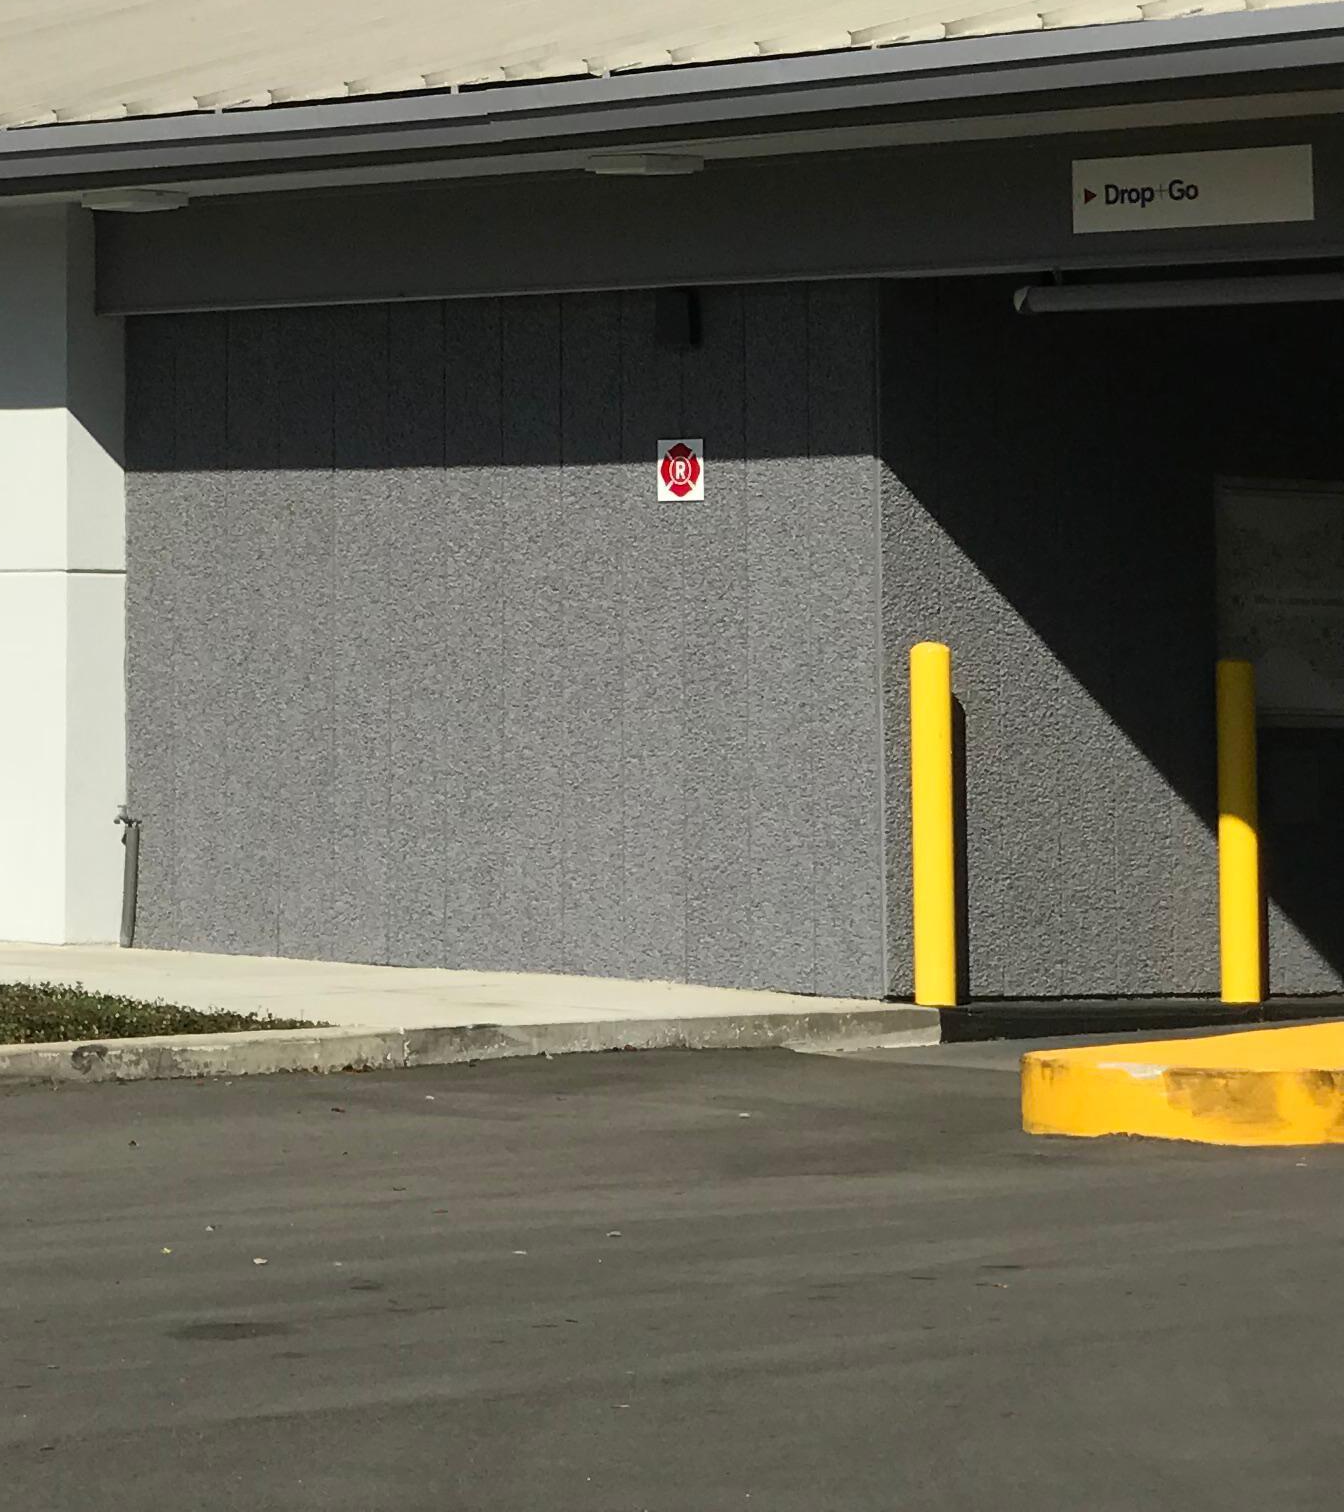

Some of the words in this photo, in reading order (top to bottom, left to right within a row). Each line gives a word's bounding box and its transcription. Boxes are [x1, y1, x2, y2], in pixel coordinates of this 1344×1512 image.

[1104, 184, 1154, 208] Drop
[1168, 179, 1199, 201] Go
[675, 460, 686, 480] R
